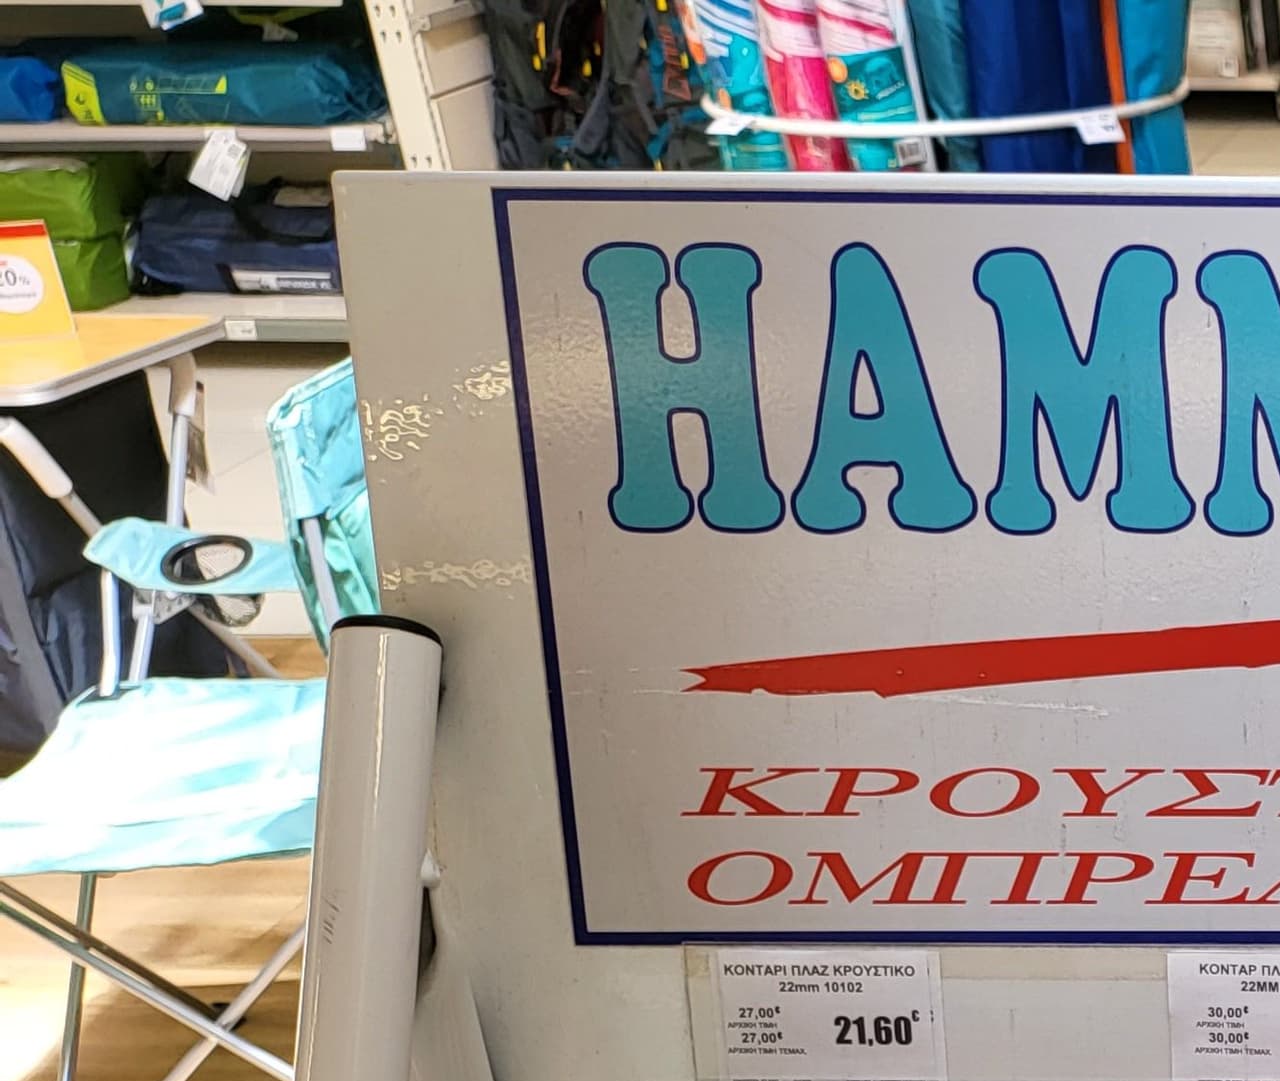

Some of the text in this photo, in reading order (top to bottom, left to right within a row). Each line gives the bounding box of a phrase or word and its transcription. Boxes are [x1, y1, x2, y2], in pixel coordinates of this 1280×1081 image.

[724, 964, 915, 977] ΚΟΝΤΑΡΙ ΠΛΑΖ ΚΡΟΥΣΤΙΚΟ
[1199, 963, 1257, 976] ΚΟΝΤΑΡ
